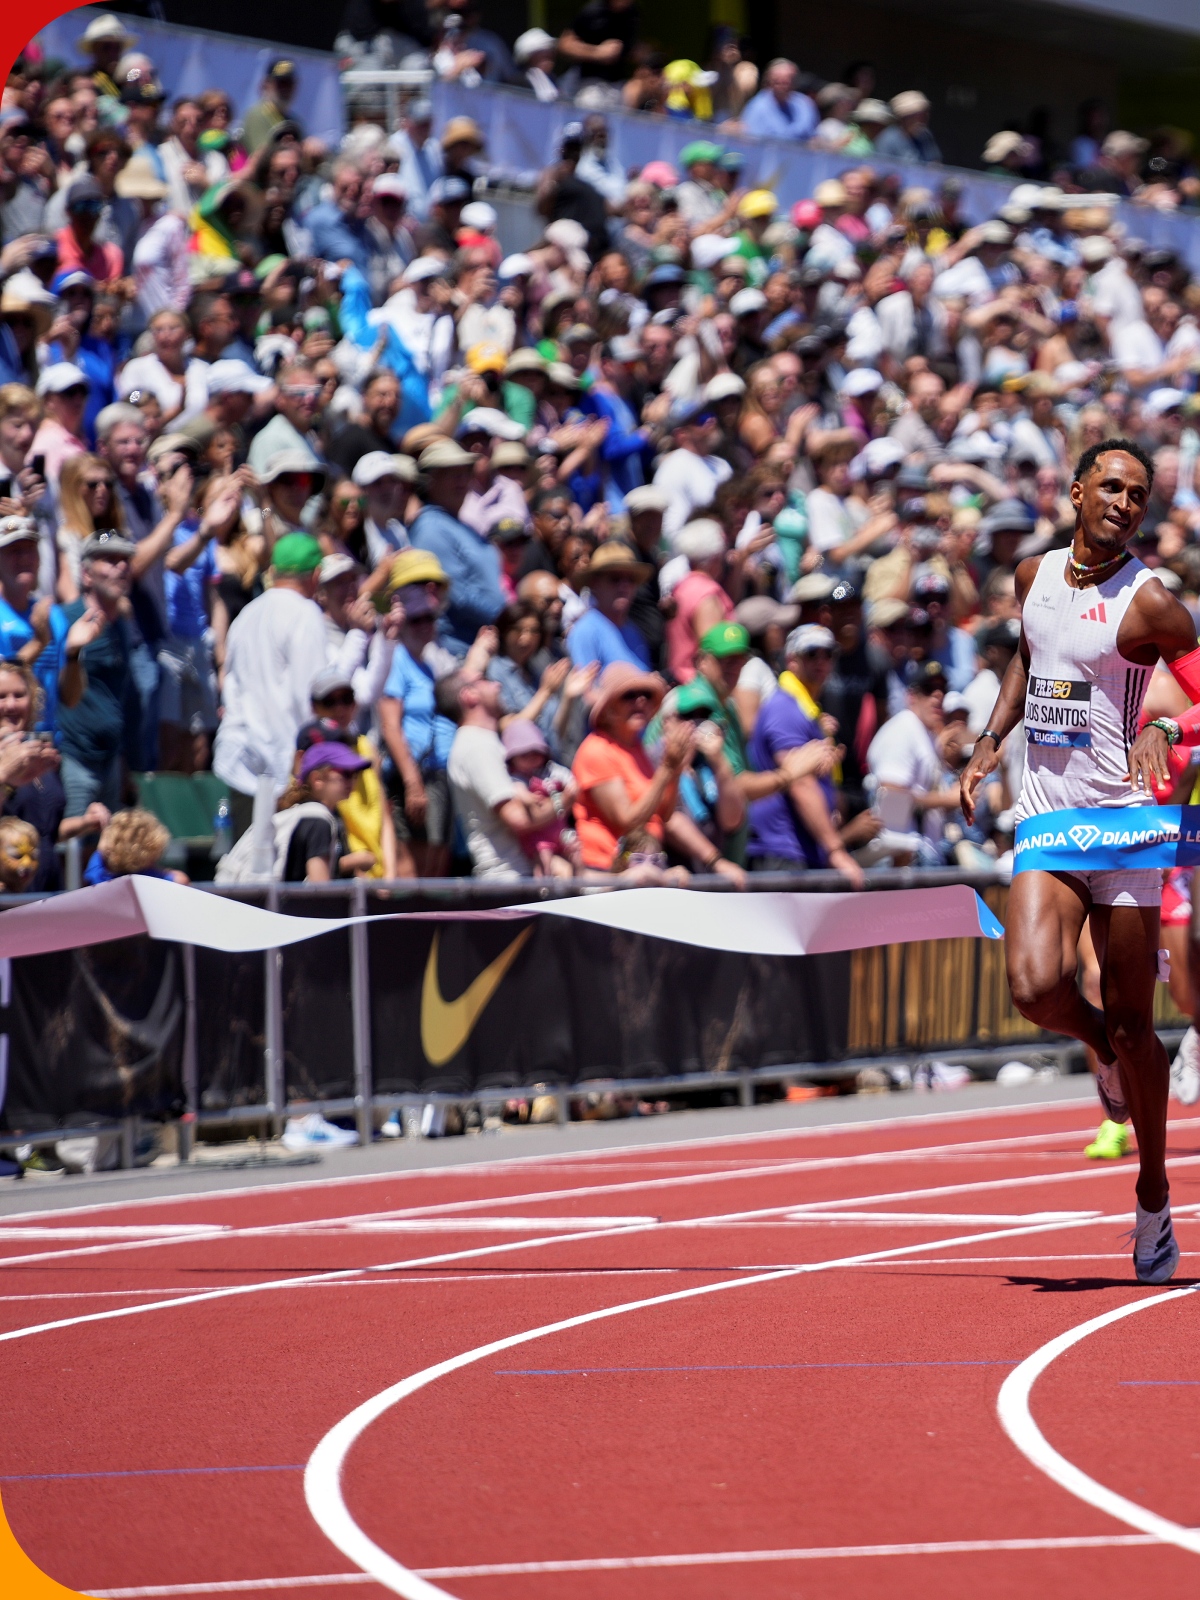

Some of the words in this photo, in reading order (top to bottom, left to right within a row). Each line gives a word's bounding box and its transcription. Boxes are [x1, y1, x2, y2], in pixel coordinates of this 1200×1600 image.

[1041, 705, 1087, 727] SANTOS
[1034, 731, 1070, 744] EUGENE
[1101, 829, 1182, 846] DIAMOND
